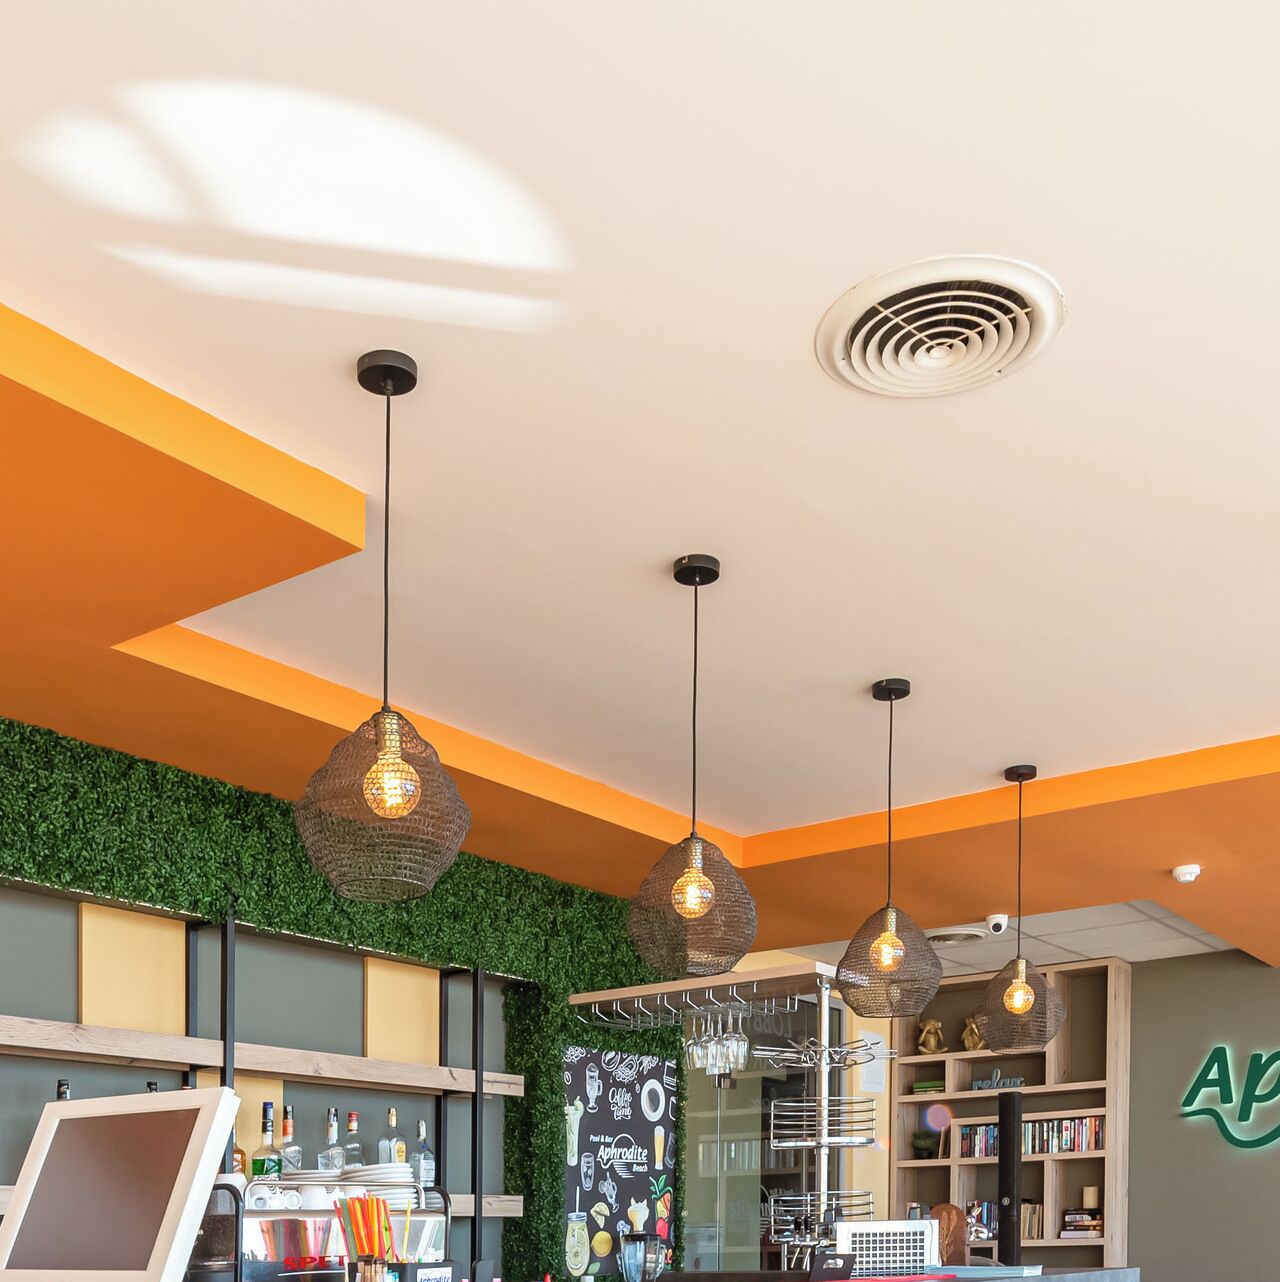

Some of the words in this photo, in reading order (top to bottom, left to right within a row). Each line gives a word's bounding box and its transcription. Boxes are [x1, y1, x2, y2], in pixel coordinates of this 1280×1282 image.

[972, 1067, 1026, 1091] relax
[597, 1145, 648, 1163] Aphrodite
[633, 1164, 648, 1172] Beach
